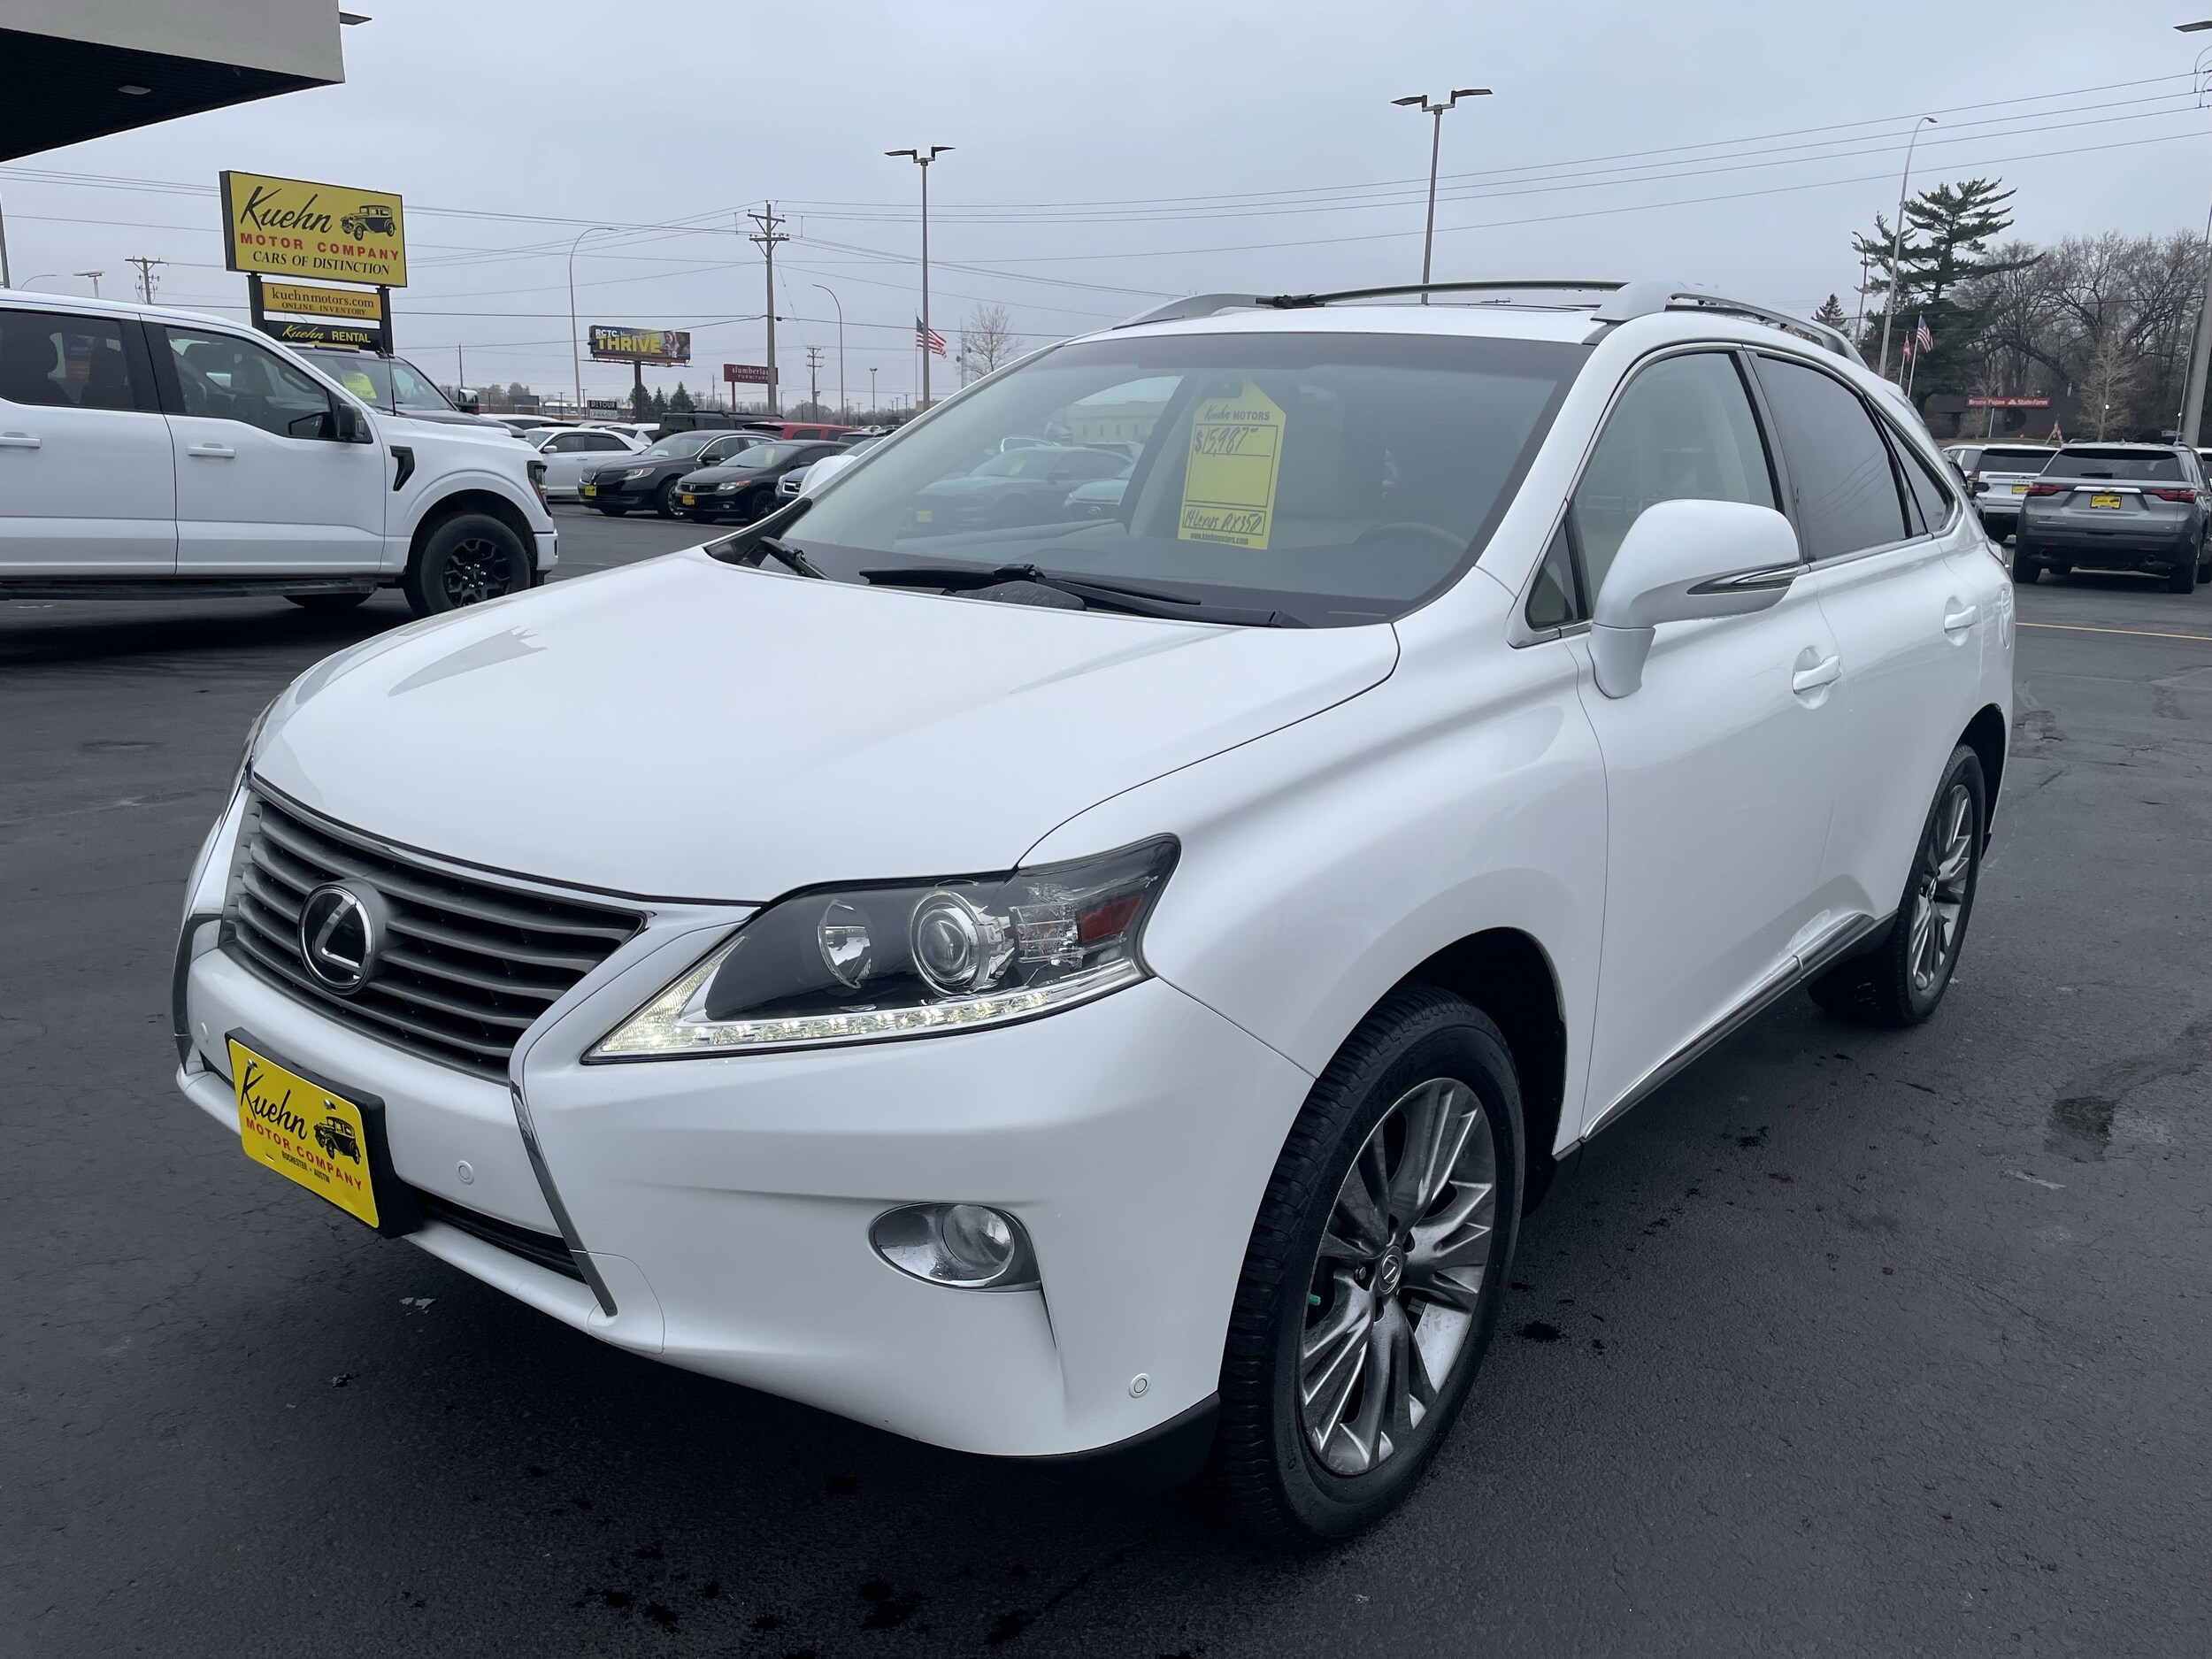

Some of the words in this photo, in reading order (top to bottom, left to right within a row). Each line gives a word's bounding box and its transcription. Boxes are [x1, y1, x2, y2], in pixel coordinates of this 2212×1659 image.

[240, 186, 333, 234] Kuehn
[240, 233, 303, 250] MOTOR
[317, 242, 399, 261] COMPANY
[253, 250, 287, 265] CARS
[292, 256, 308, 266] OF
[313, 257, 390, 276] DISTINCTION
[272, 288, 374, 308] kuehnmotors.com
[281, 302, 314, 311] ONLINE
[319, 305, 366, 316] INVENTORY
[281, 325, 325, 340] Kuehn
[331, 330, 372, 343] RENTAL
[595, 328, 619, 338] RCTC.
[1233, 411, 1271, 420] MOTORS
[241, 1065, 308, 1141] Kuehn
[246, 1116, 291, 1151] MOTOR
[296, 1145, 362, 1191] COMPANY
[281, 1150, 308, 1171] ROCHESTER
